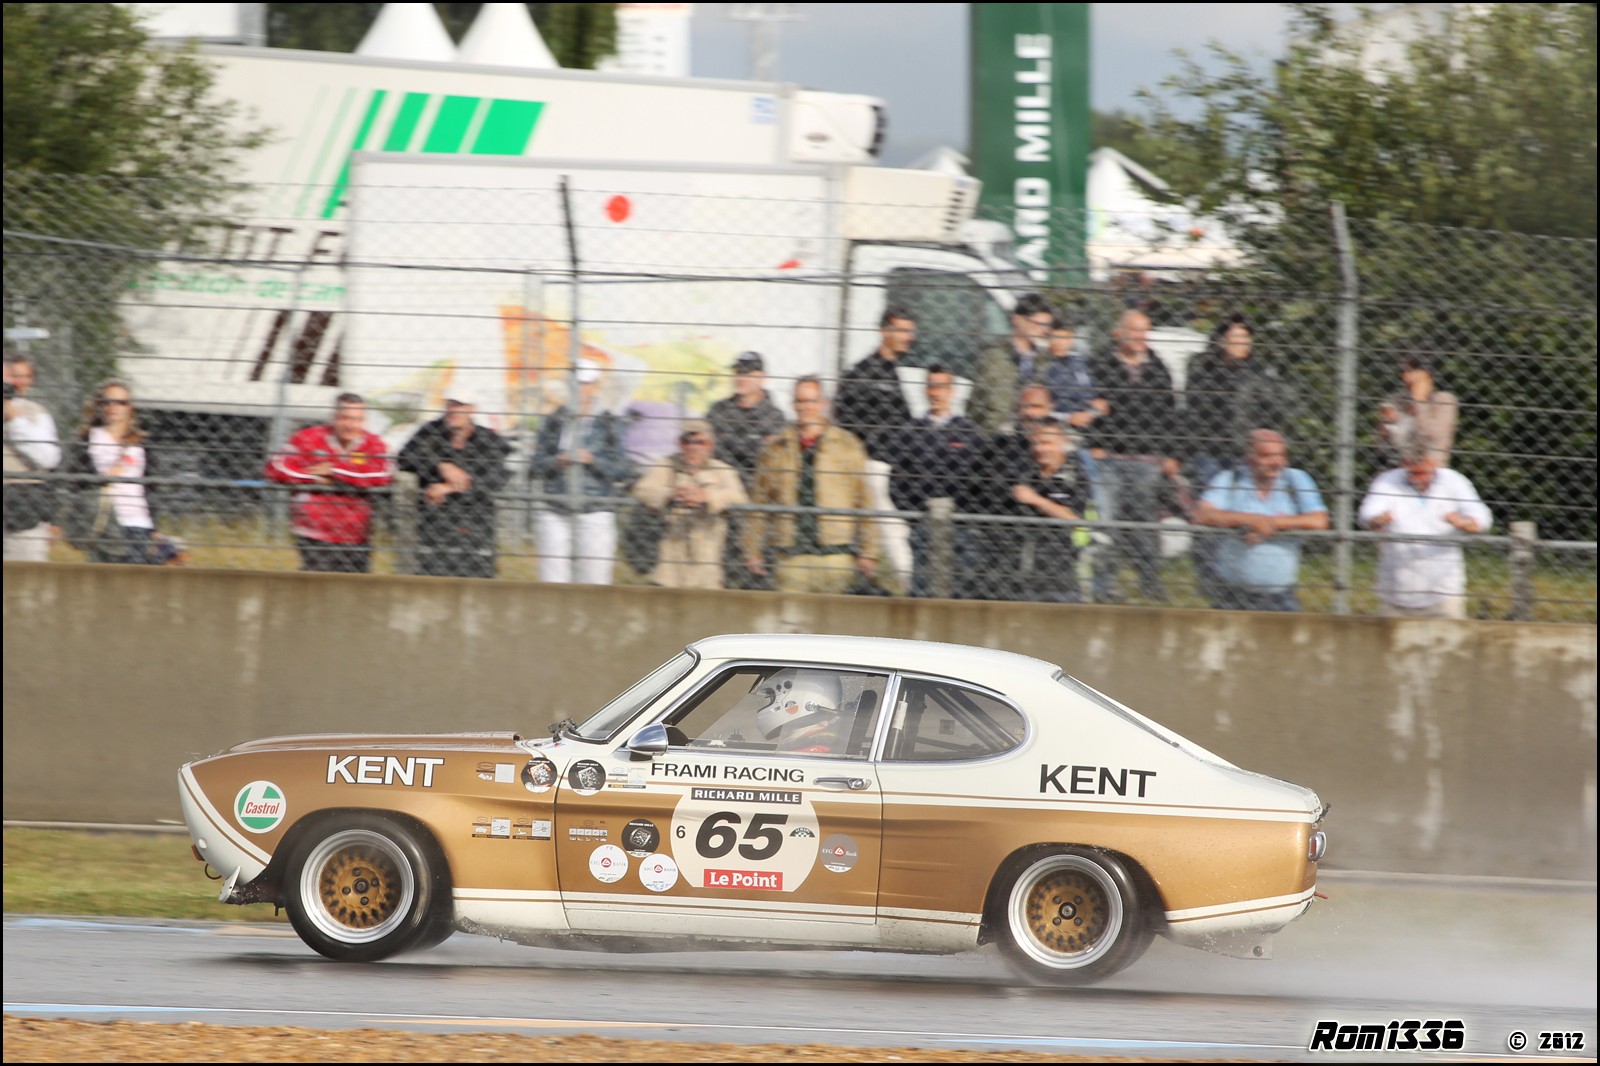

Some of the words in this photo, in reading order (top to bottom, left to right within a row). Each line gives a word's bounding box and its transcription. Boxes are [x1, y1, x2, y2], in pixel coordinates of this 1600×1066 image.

[1014, 33, 1053, 162] MILLE
[326, 755, 444, 787] KENT
[651, 762, 717, 778] FRAMI
[724, 766, 805, 783] RACING
[1040, 764, 1157, 798] KENT
[245, 801, 280, 815] Castrol
[694, 789, 755, 801] RICHARD
[759, 792, 800, 803] MILLE
[676, 825, 686, 839] 6
[695, 811, 789, 861] 65
[709, 872, 728, 885] Le
[732, 873, 778, 888] Point
